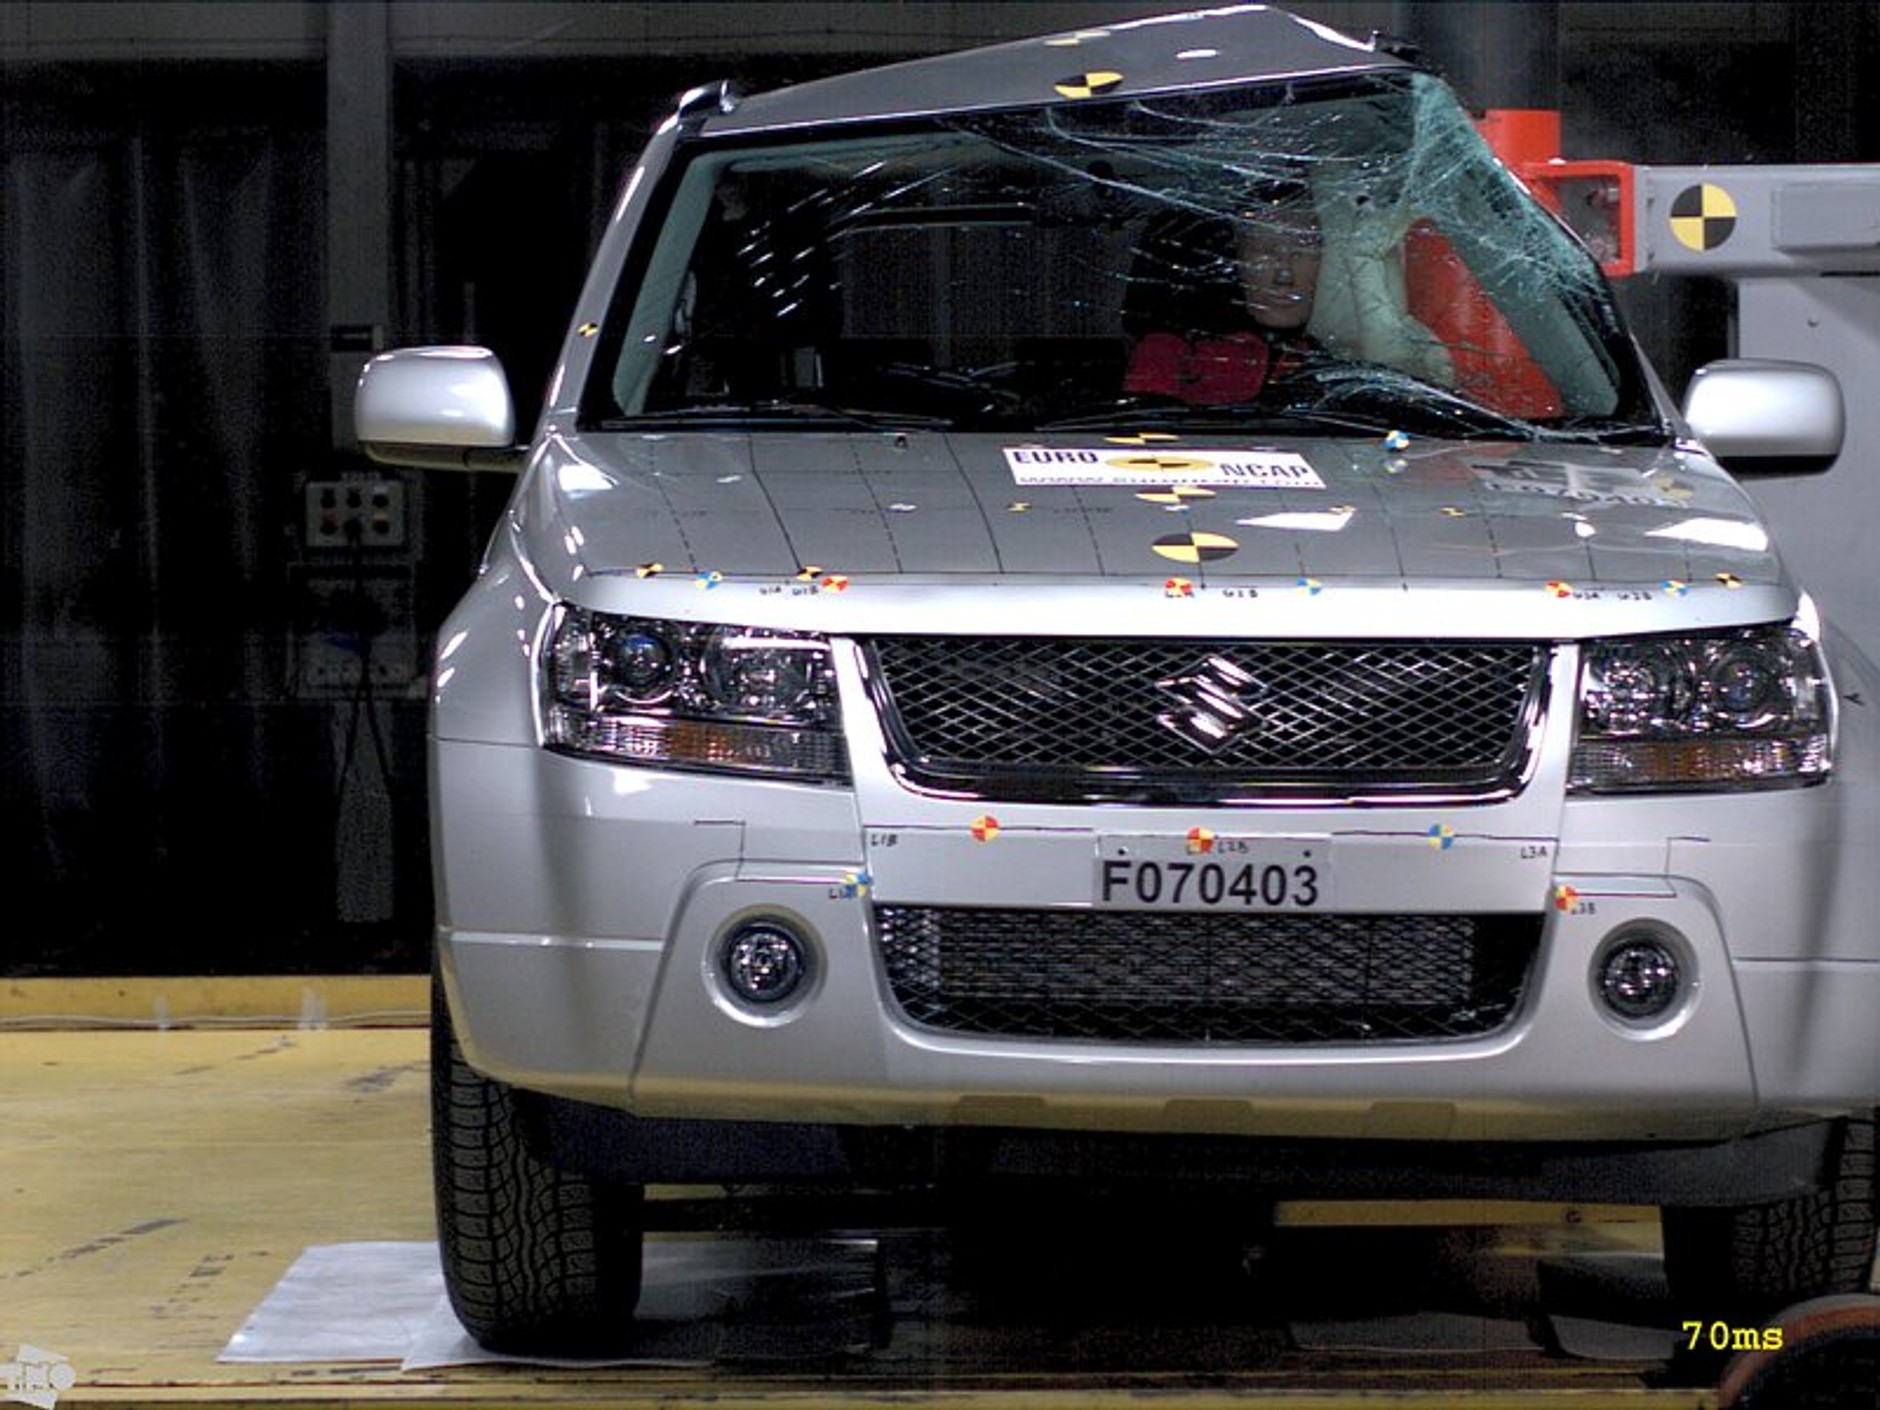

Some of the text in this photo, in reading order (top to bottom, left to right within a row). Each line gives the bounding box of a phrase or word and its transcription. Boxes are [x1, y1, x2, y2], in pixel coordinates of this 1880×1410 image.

[1013, 451, 1309, 478] EURO NCAP
[1102, 861, 1319, 907] F070403
